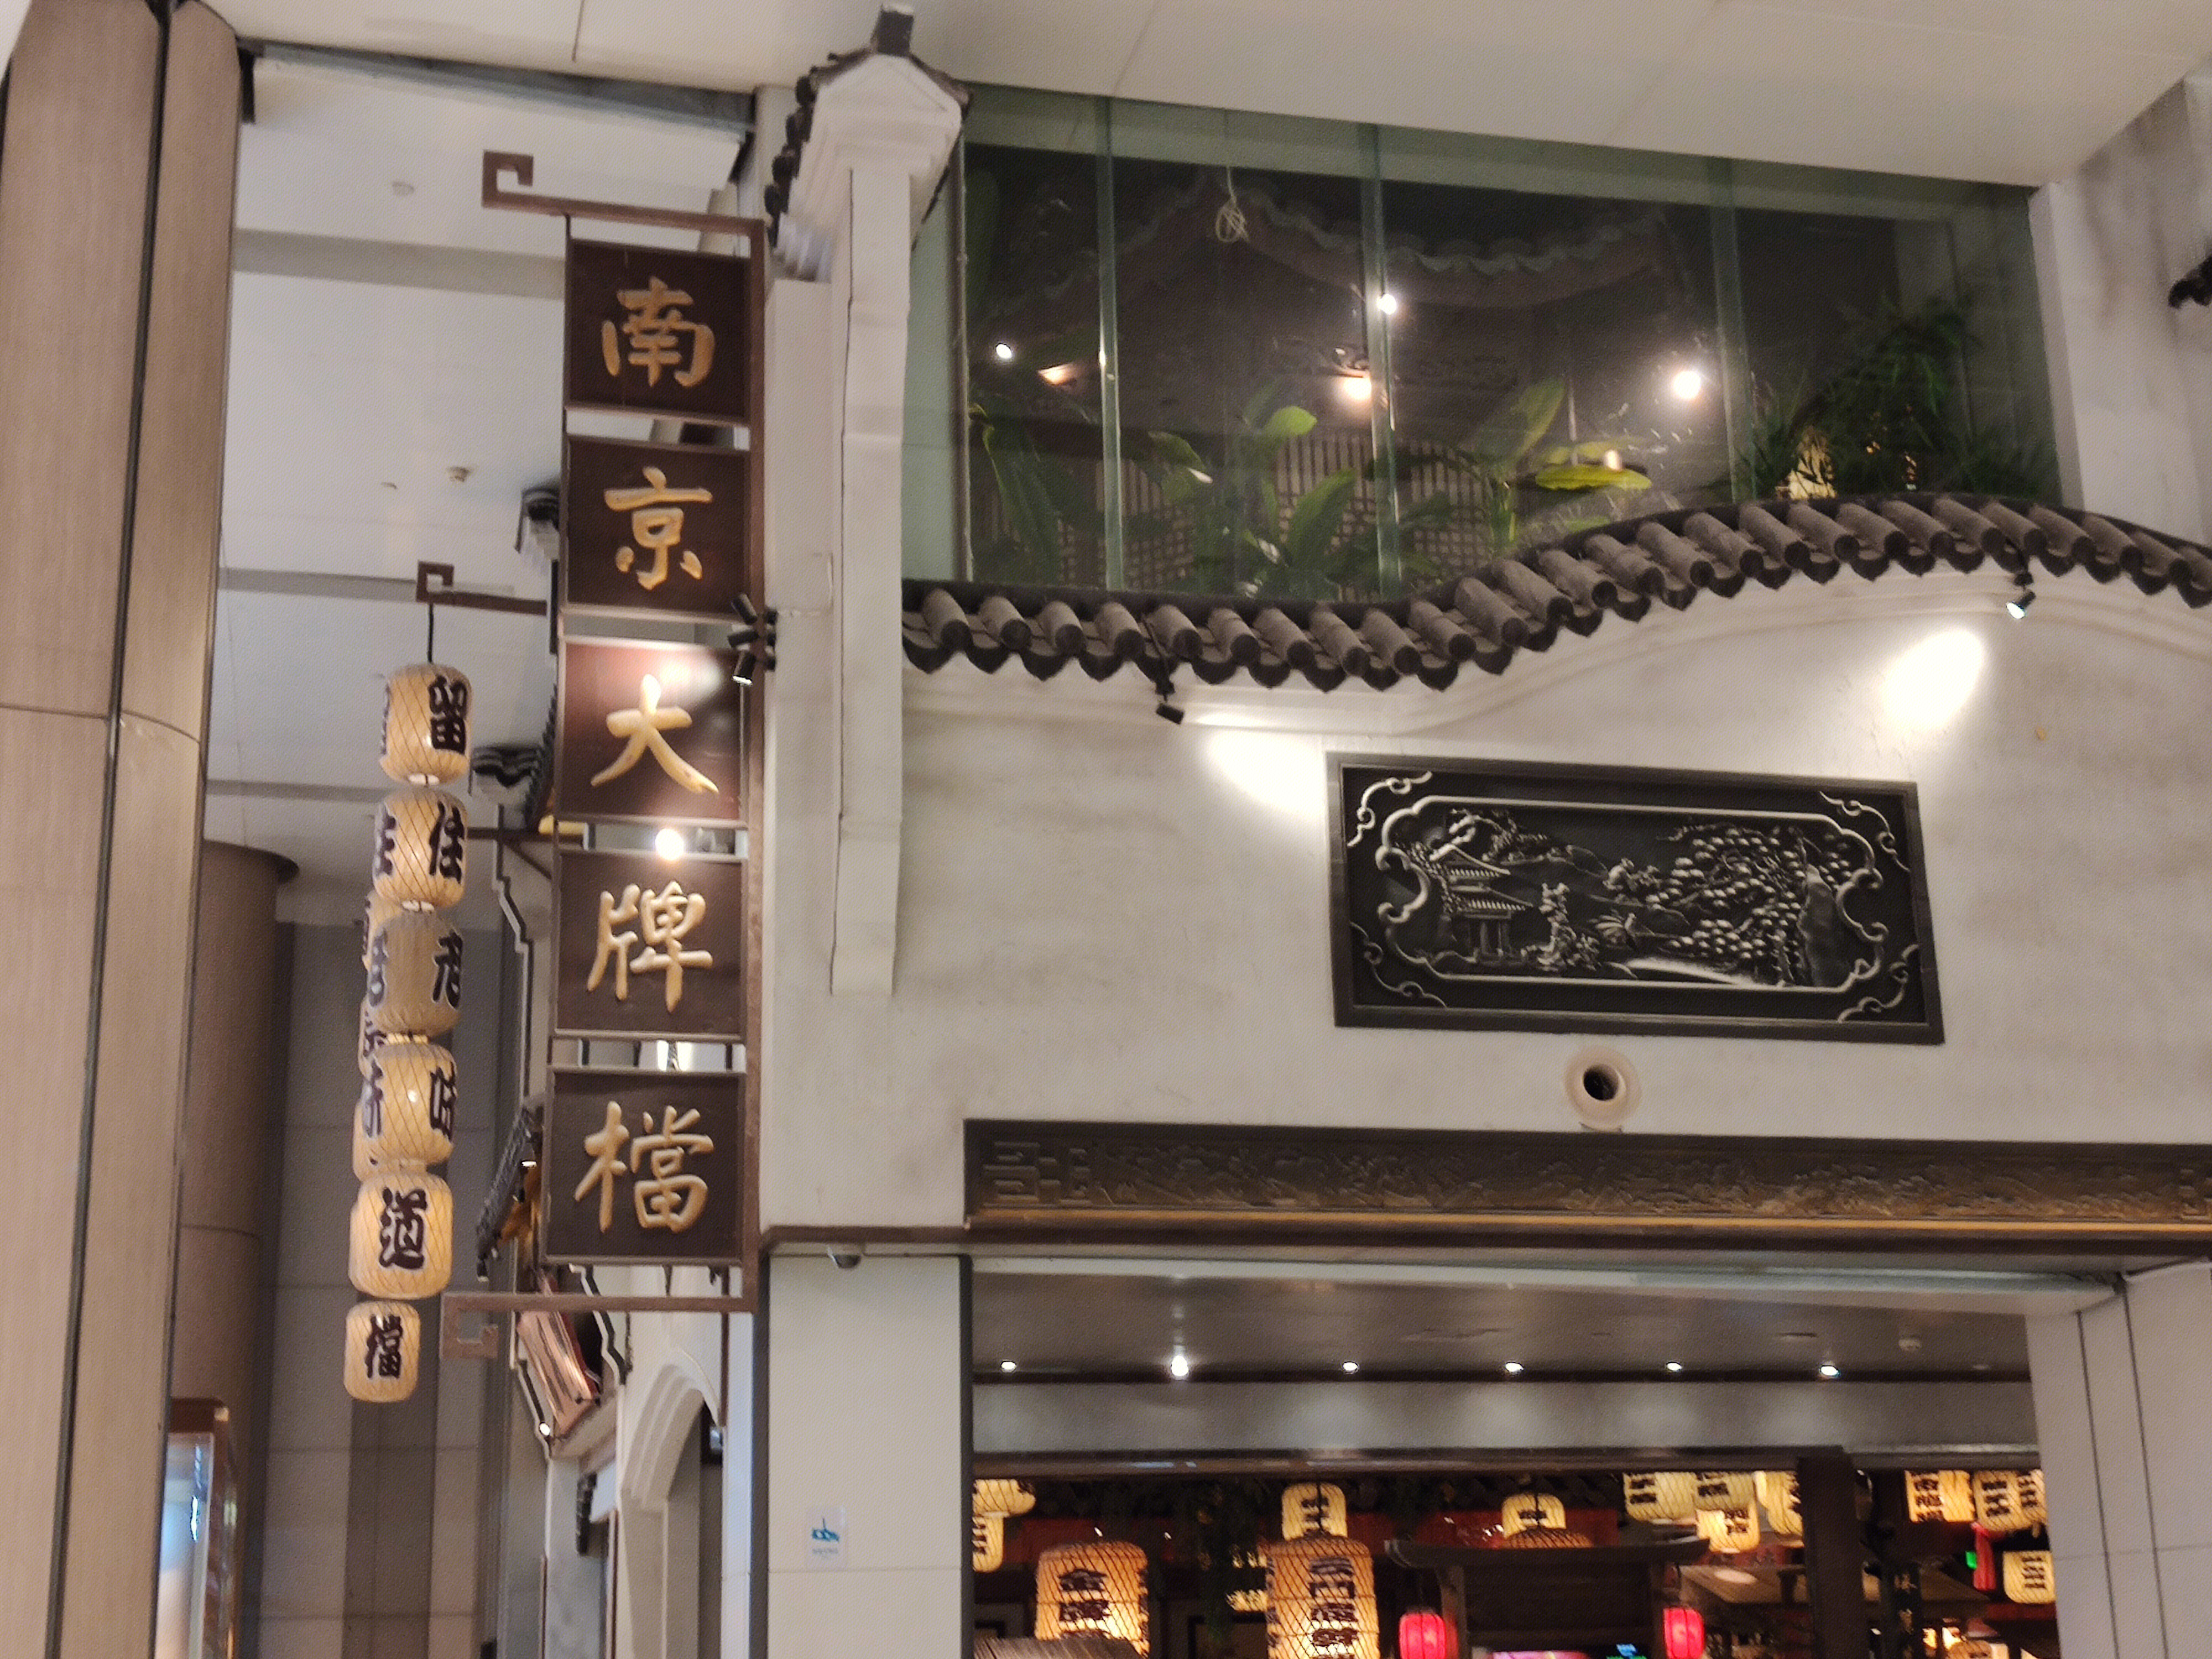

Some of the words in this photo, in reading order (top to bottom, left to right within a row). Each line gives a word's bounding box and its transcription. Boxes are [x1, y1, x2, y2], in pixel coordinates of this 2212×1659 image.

[574, 275, 719, 1233] 南京大牌檔
